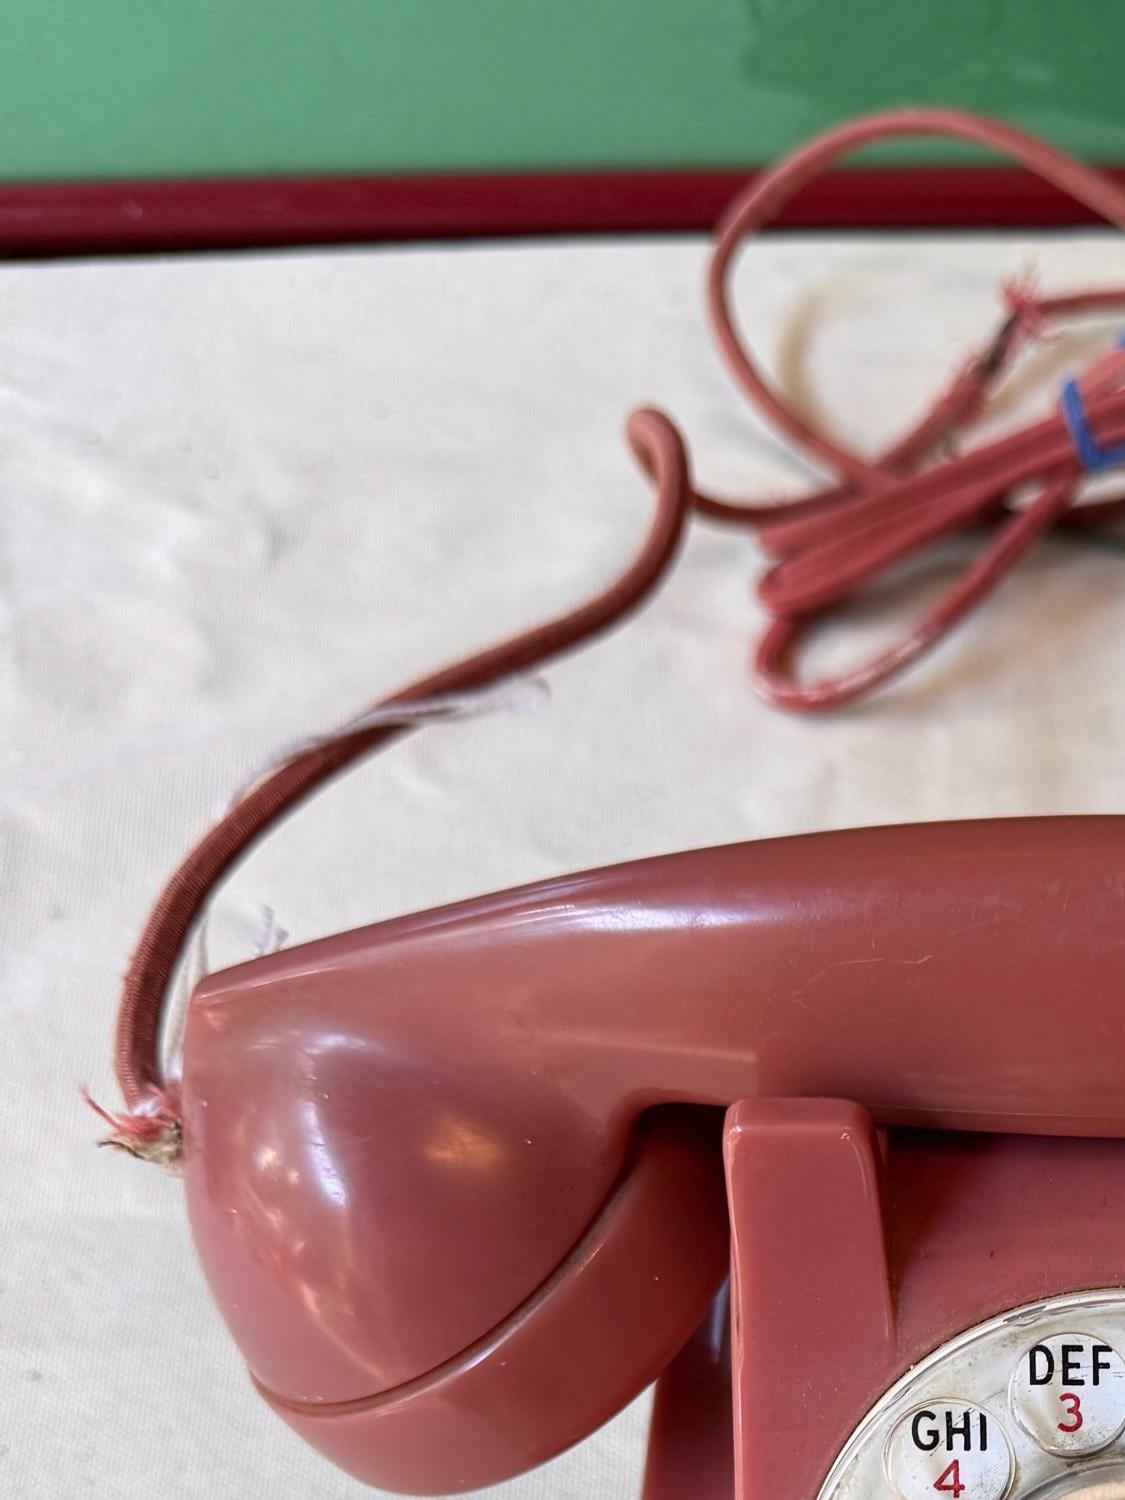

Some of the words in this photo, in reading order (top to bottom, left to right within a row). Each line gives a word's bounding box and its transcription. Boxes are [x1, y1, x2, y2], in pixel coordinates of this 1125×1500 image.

[1029, 1345, 1113, 1386] DEF
[911, 1411, 988, 1451] GHI
[1057, 1393, 1084, 1432] 3
[933, 1460, 965, 1498] 4
